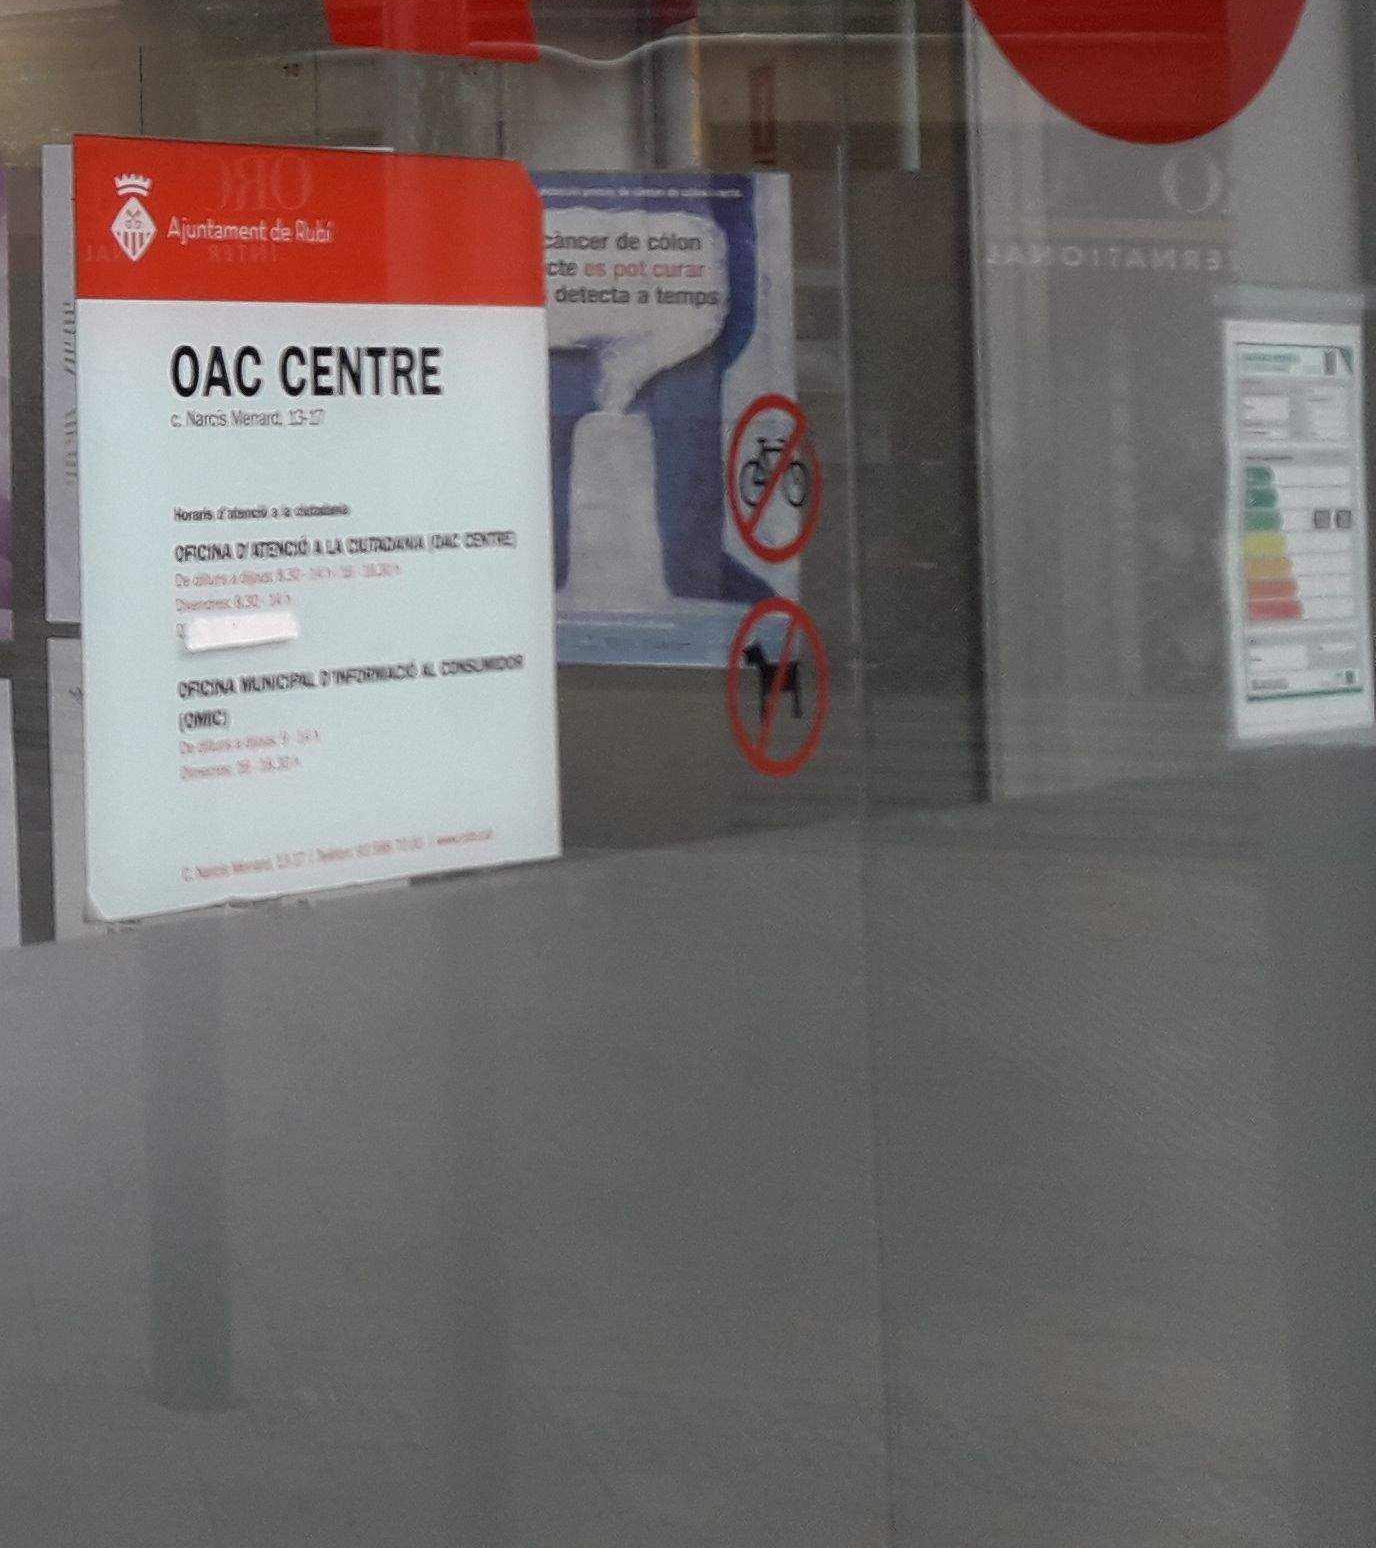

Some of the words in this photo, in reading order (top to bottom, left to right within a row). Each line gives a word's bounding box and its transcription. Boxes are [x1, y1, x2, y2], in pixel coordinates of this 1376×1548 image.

[166, 215, 268, 243] Ajuntament
[268, 218, 294, 242] de
[294, 218, 334, 243] Rubí
[614, 231, 640, 251] de
[645, 231, 704, 252] còlon
[553, 284, 630, 304] detecta
[636, 289, 650, 304] a
[654, 285, 723, 309] temps
[170, 344, 261, 397] OAC
[279, 345, 441, 396] CENTRE
